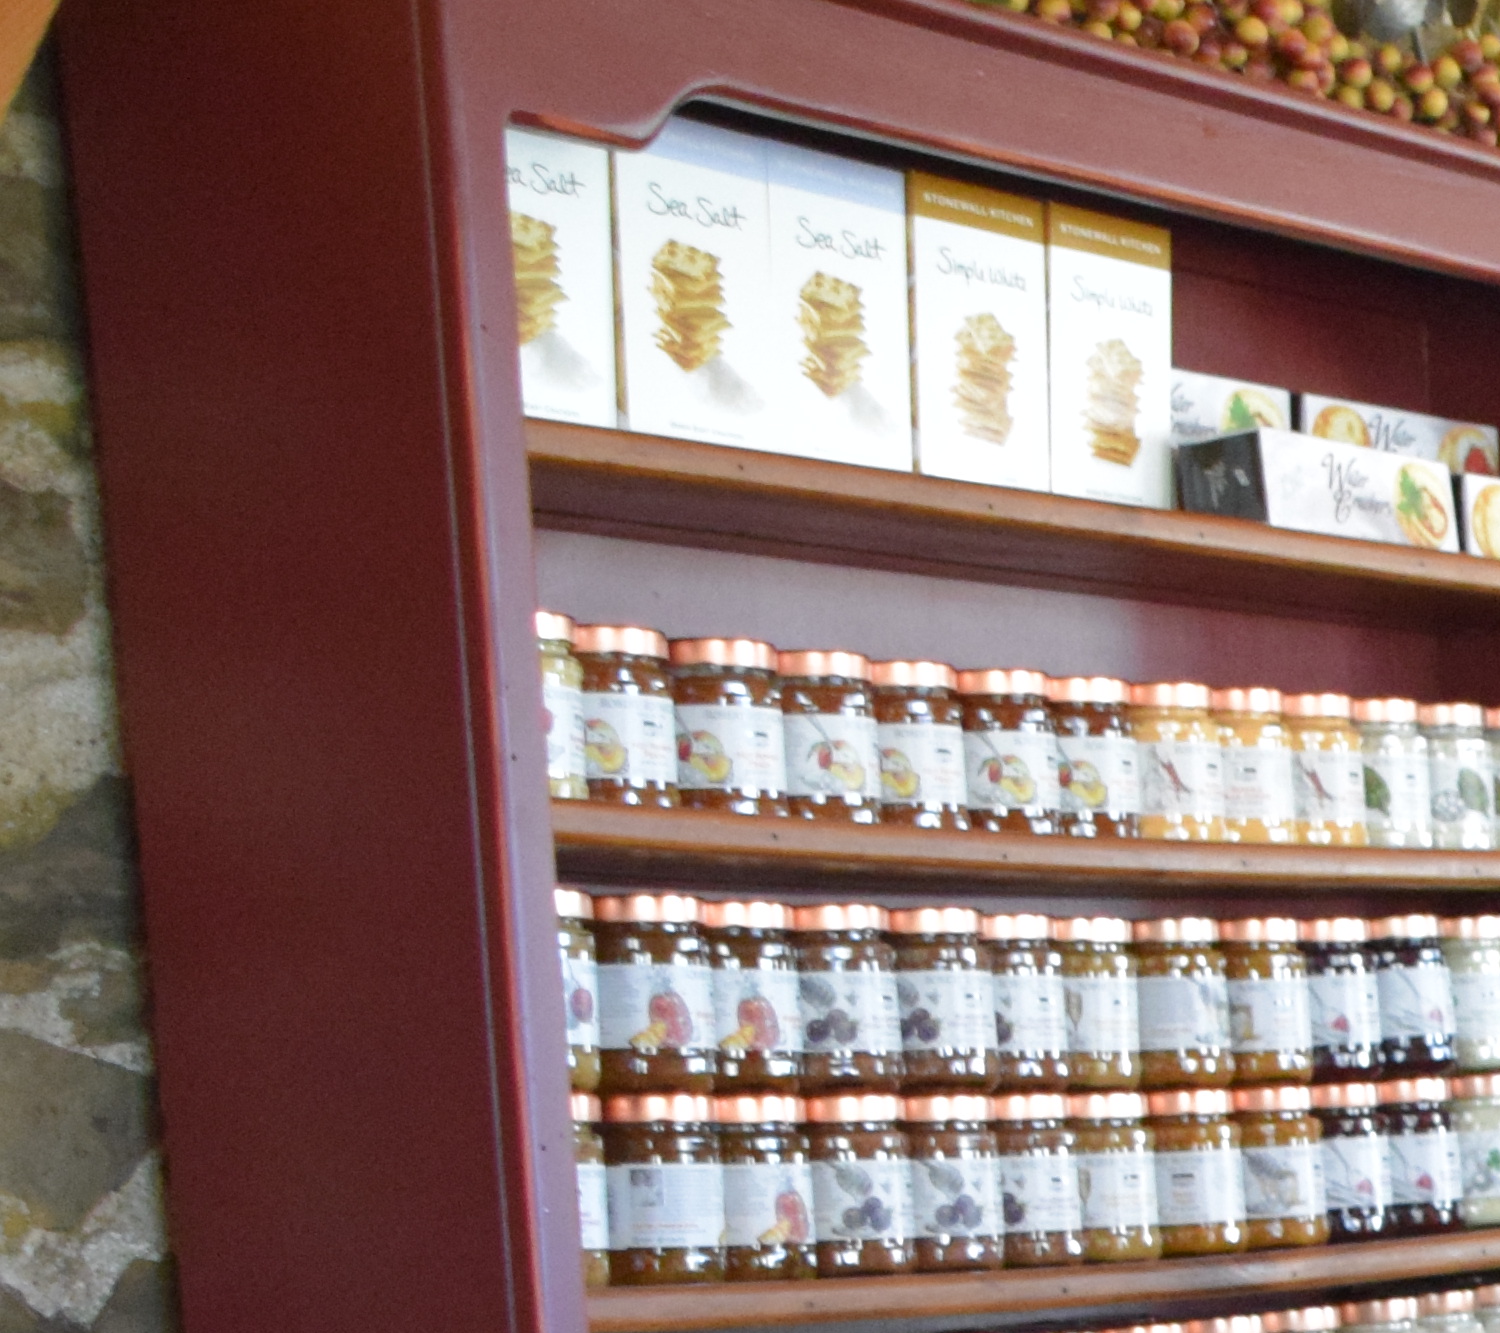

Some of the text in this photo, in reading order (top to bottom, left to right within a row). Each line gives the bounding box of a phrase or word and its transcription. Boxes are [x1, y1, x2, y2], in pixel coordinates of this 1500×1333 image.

[530, 163, 587, 198] Salt
[646, 181, 748, 231] Sea Salt
[923, 191, 1034, 228] STONEWALL KITCHEN
[794, 215, 888, 262] Sea Salt
[1059, 222, 1161, 255] STONEWALL KITCHEN
[937, 246, 985, 286] Simple
[1070, 275, 1115, 312] Simple
